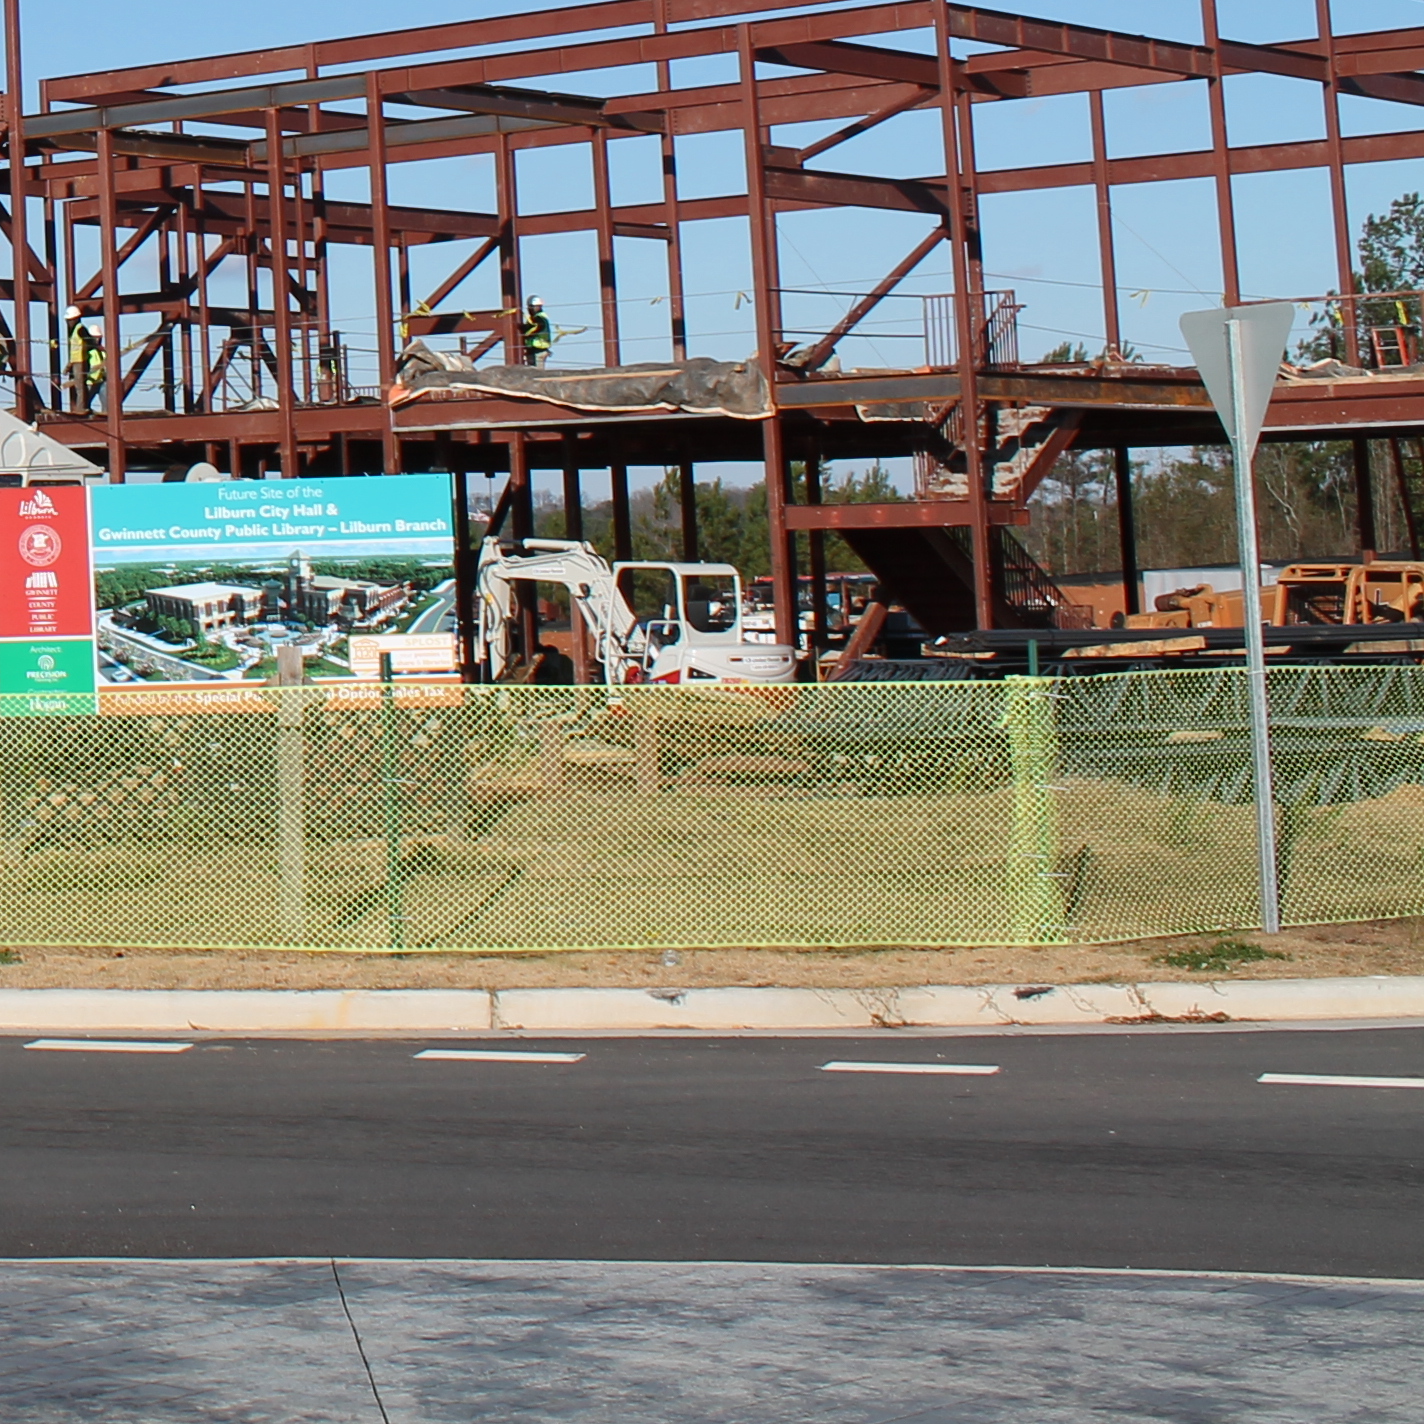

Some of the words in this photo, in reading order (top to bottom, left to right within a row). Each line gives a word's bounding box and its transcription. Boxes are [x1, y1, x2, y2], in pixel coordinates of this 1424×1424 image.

[218, 487, 258, 500] Future
[260, 486, 283, 499] Site
[286, 486, 300, 498] of
[302, 486, 323, 497] the
[19, 500, 59, 516] Lilburn
[204, 506, 256, 519] Lilburn
[259, 505, 290, 520] City
[293, 503, 322, 516] Hall
[326, 503, 338, 515] &
[98, 528, 166, 541] Gwinnett
[169, 525, 222, 540] County
[225, 524, 269, 537] Public
[272, 523, 325, 537] Library
[340, 520, 391, 533] Lilburn
[395, 518, 447, 531] Branch
[404, 637, 449, 646] SPLOST
[195, 691, 241, 706] Special
